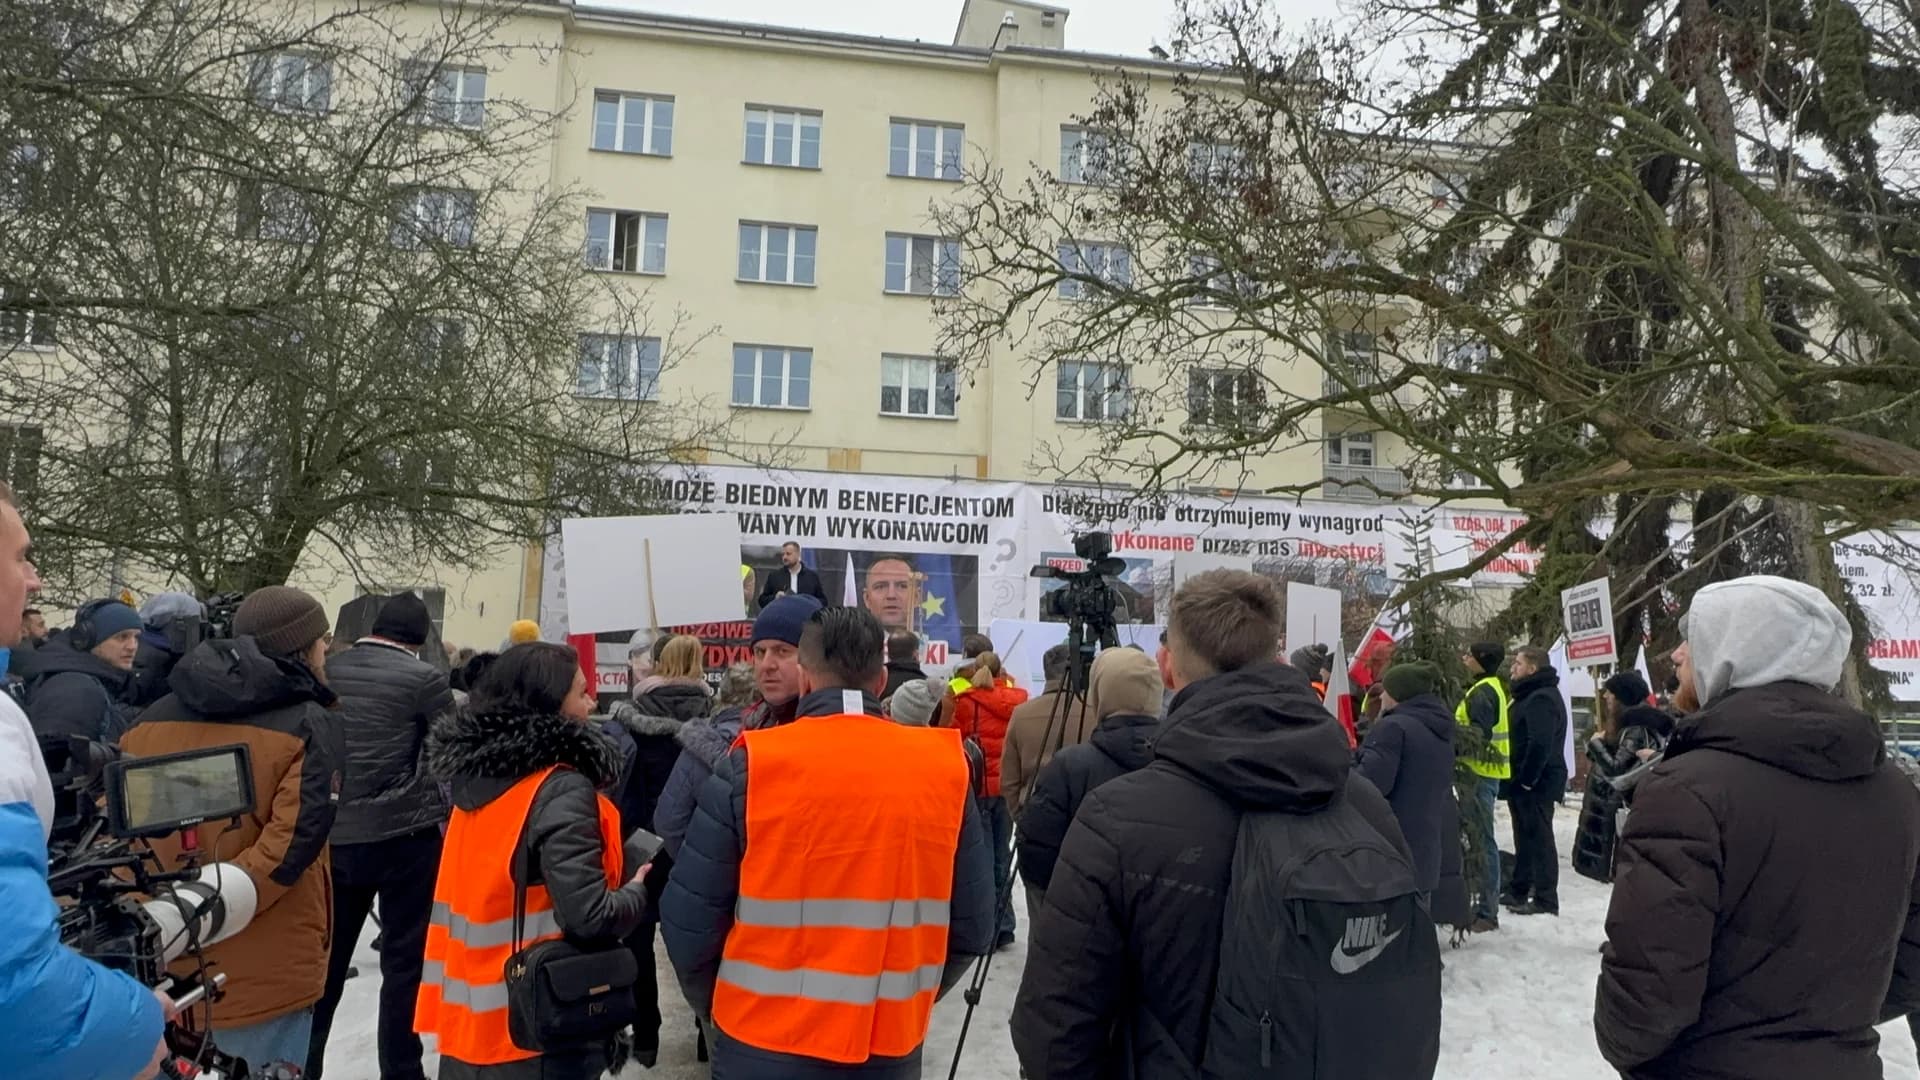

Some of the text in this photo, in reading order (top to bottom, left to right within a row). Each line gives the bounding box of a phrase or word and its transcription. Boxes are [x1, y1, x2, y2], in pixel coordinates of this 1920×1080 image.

[637, 474, 1014, 518] OMOŻE BIEDNYM BENEFICJENTOM
[738, 512, 989, 545] WANYM WYKONAWCOM
[1175, 505, 1291, 532] otrzymujemy
[1114, 530, 1195, 551] ykonane
[1203, 538, 1250, 554] przez
[1259, 541, 1290, 557] nas
[1298, 538, 1384, 564] inwestycj
[925, 643, 946, 665] KI
[1867, 639, 1920, 659] OGAM
[1343, 913, 1387, 949] NIKE
